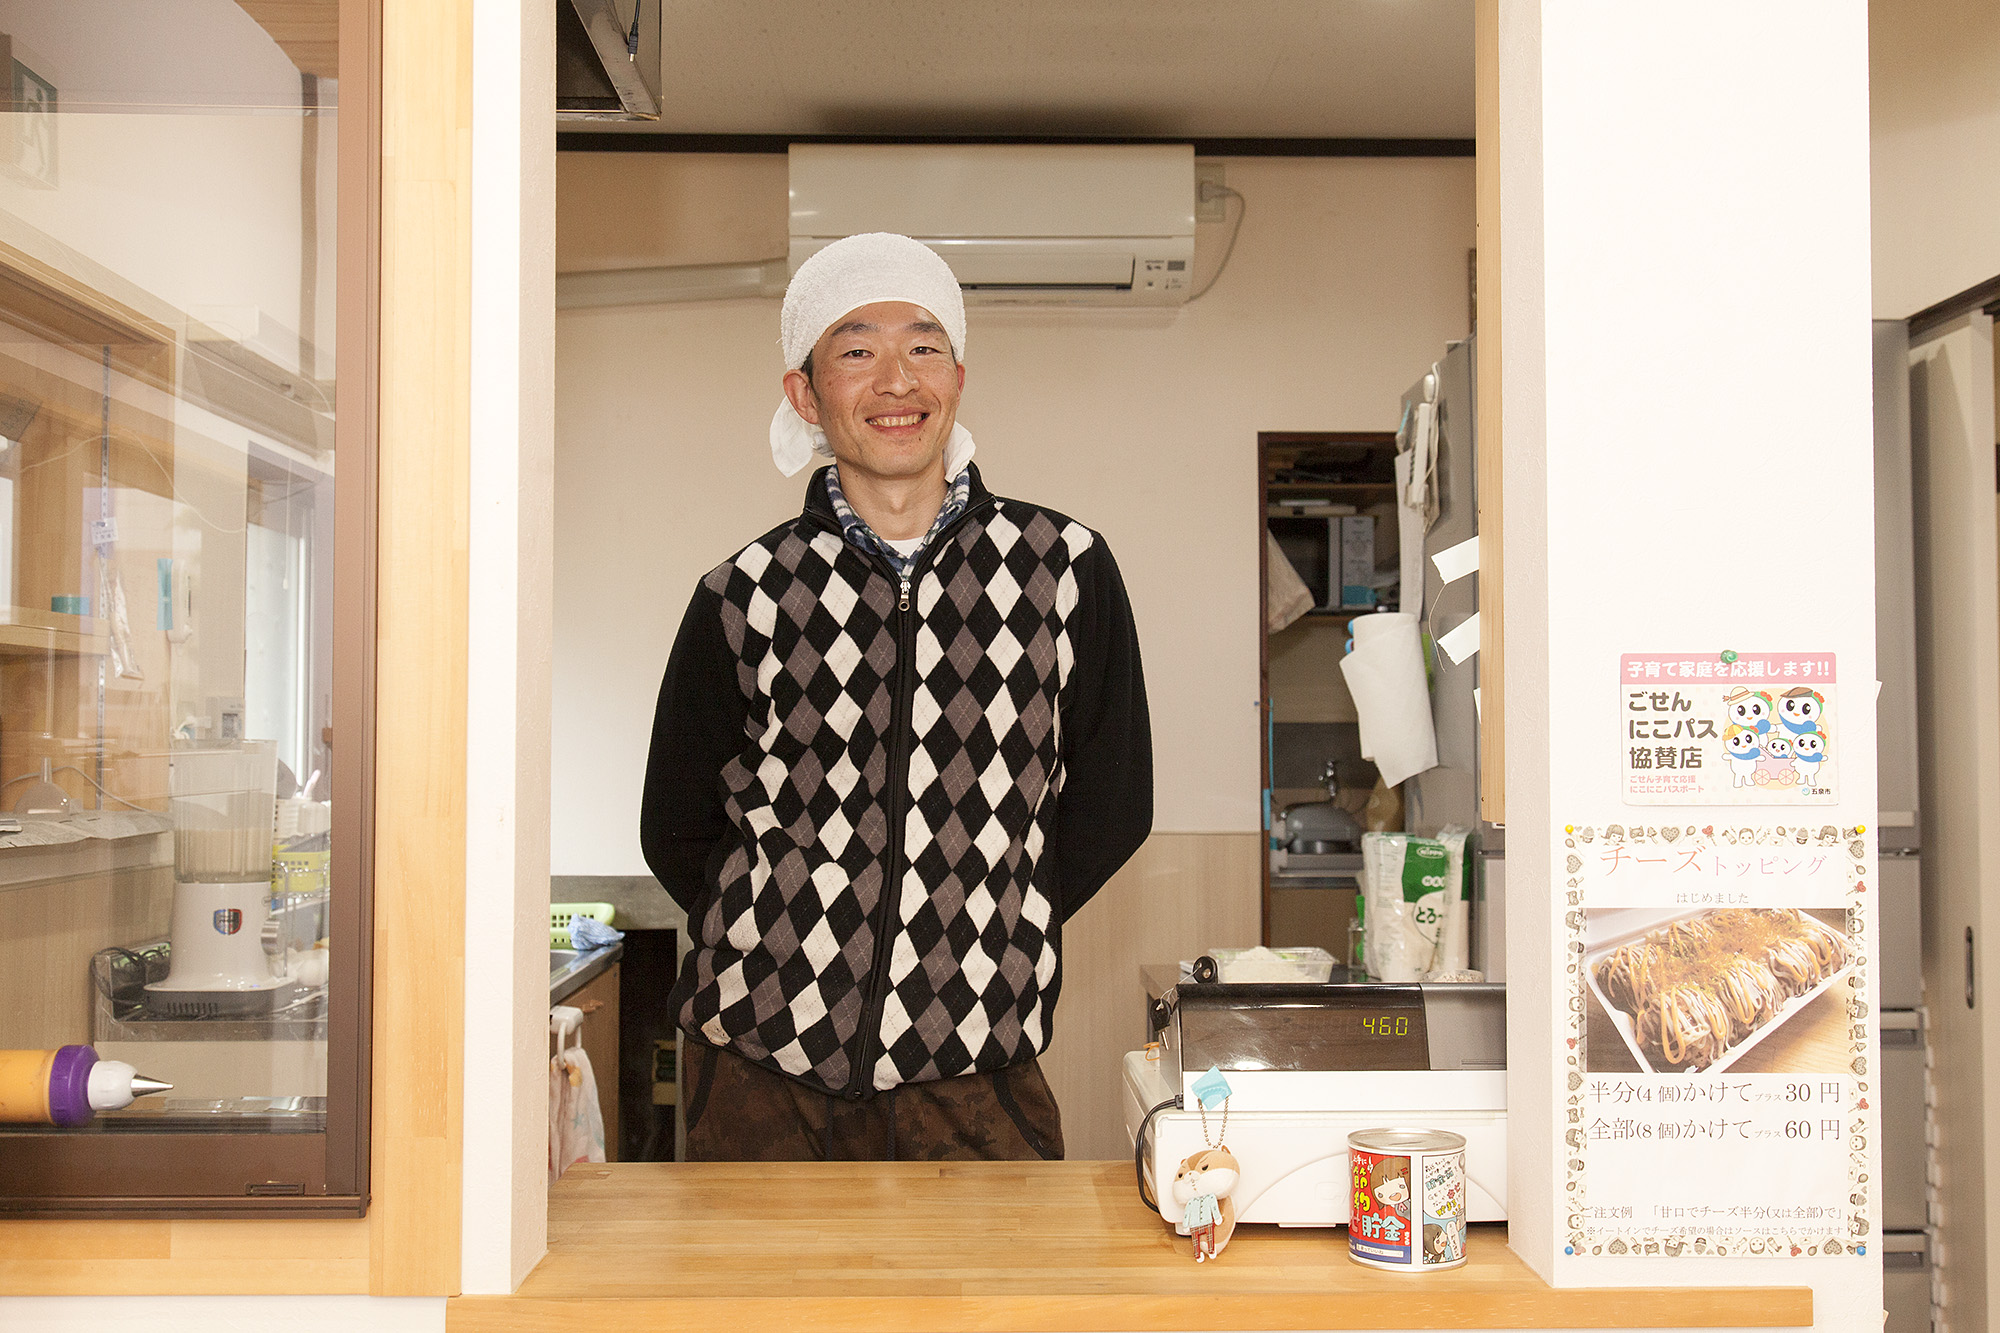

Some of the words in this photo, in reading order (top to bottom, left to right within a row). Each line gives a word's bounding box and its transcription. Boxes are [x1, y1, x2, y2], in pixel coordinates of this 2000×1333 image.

[1626, 660, 1830, 678] 子育て家庭を応援します!!
[1628, 691, 1692, 712] ごせん
[1629, 719, 1718, 740] にこパス
[1629, 746, 1703, 770] 協賛店
[1629, 774, 1697, 784] ごせん子育て応援
[1629, 784, 1705, 794] にこにこパスポート
[1811, 787, 1831, 795] 五泉市
[1675, 892, 1750, 905] はじめました
[1363, 1017, 1409, 1036] 460
